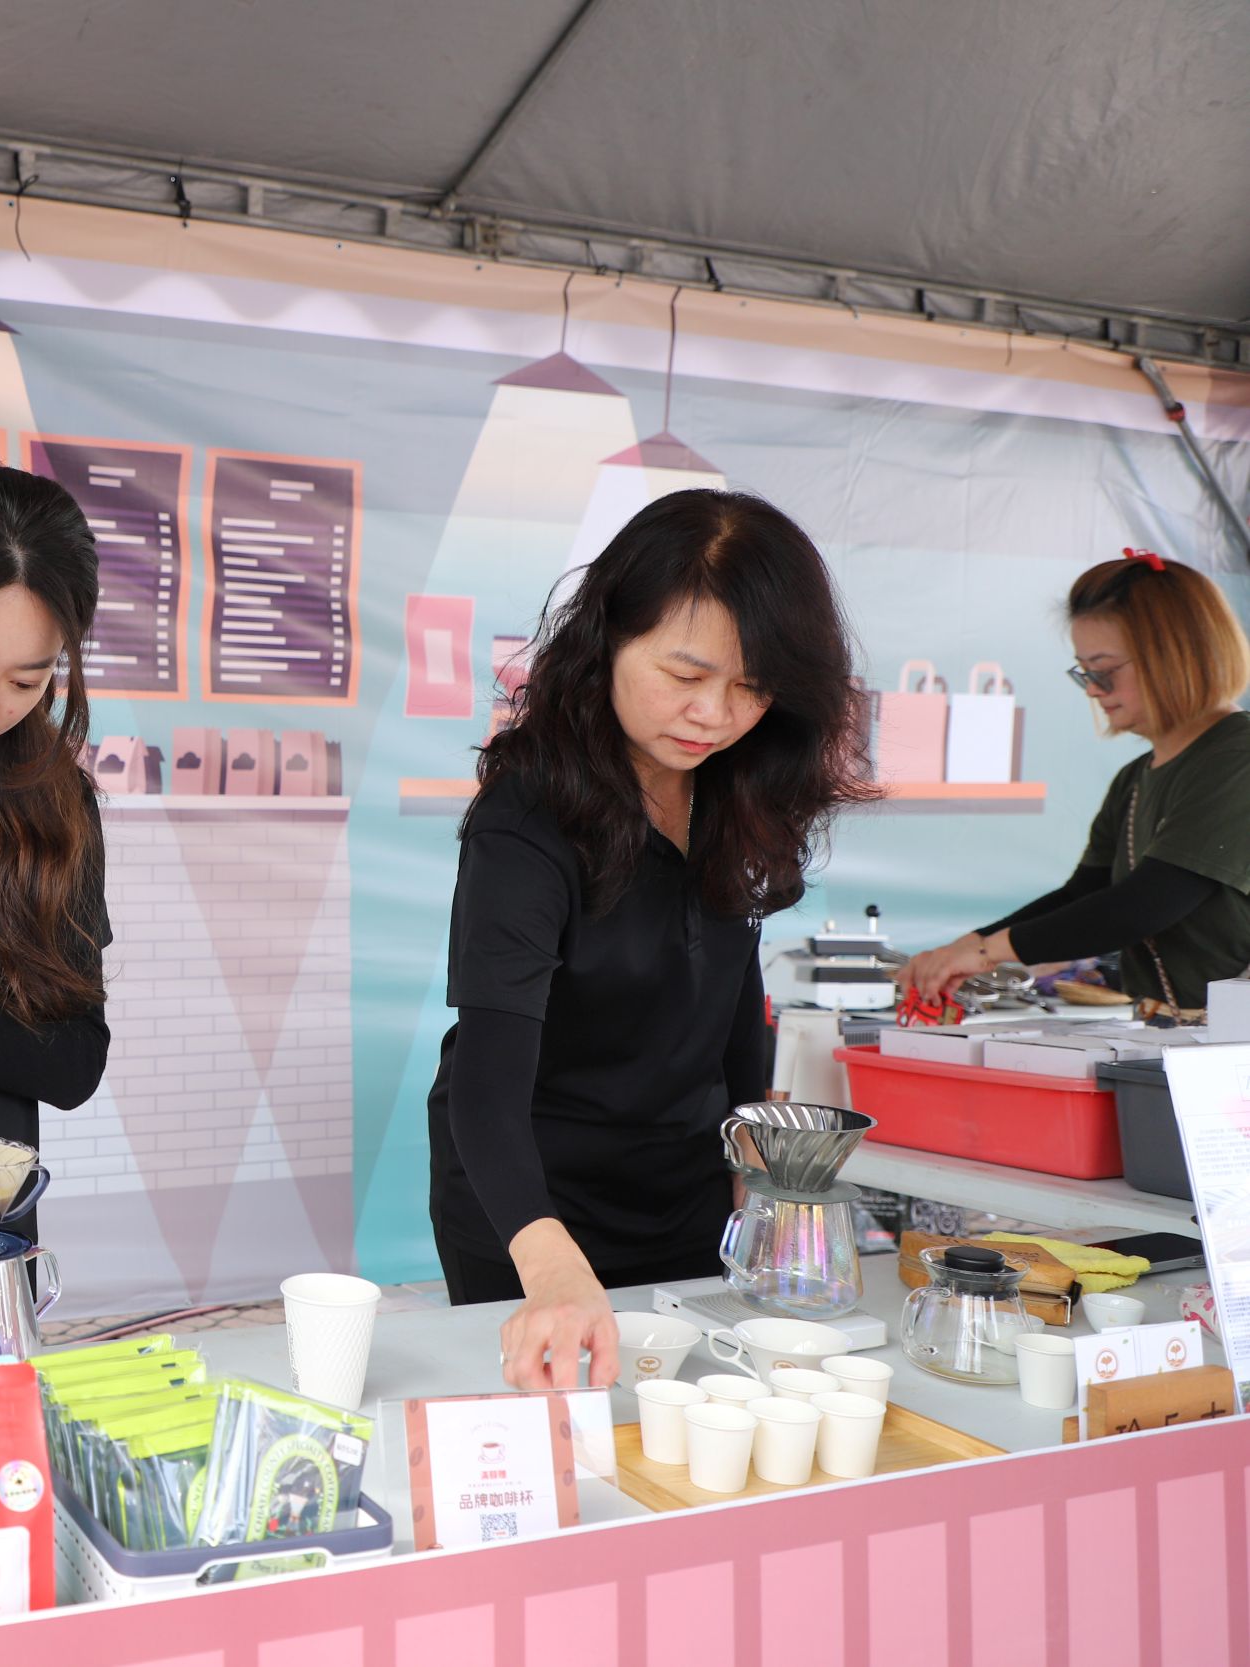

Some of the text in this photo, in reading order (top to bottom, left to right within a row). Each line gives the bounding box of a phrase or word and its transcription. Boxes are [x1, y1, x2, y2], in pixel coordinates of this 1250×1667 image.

[459, 1490, 534, 1510] 品牌咖啡杯
